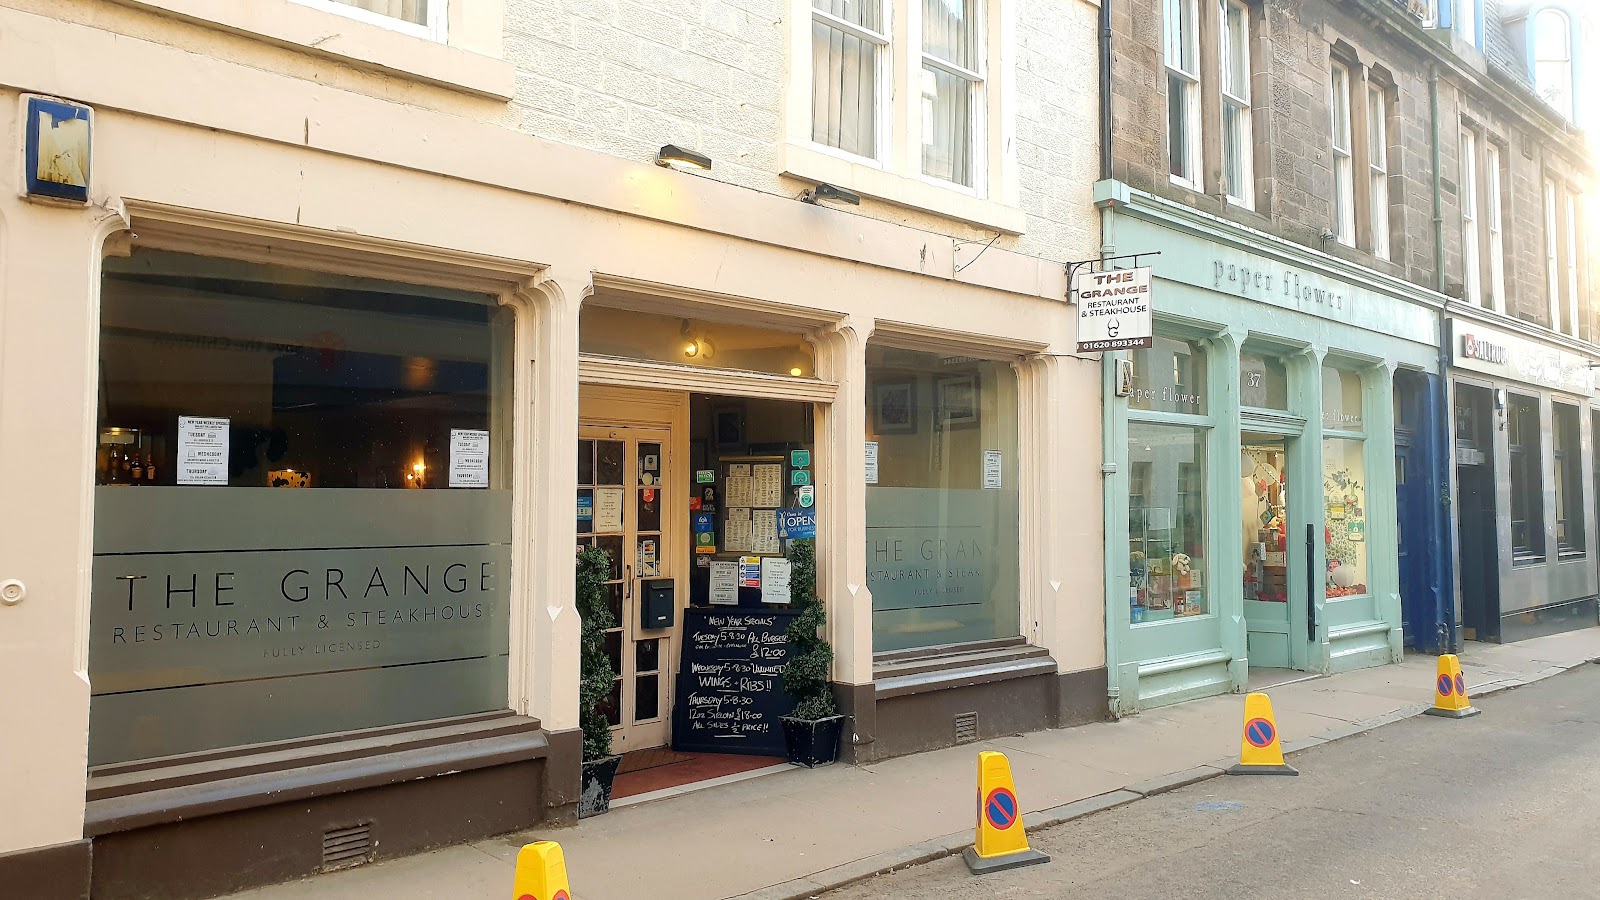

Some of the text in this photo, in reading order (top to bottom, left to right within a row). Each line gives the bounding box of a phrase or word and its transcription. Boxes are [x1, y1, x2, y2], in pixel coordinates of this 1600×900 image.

[1094, 272, 1133, 286] THE
[1213, 259, 1273, 295] paper
[1080, 285, 1148, 299] GRANGE
[1087, 297, 1140, 309] RESTAURANT
[1089, 304, 1147, 317] STEAKHOUSE
[1083, 339, 1145, 350] 01620 893344
[1247, 371, 1262, 388] 37
[1129, 386, 1200, 405] aper flower
[787, 516, 816, 527] OPEN
[866, 539, 982, 562] HE GRAN
[870, 568, 930, 582] STAURANT
[115, 562, 495, 611] THE GRANGE
[113, 615, 300, 644] RESTAURANT
[317, 613, 330, 630] &
[726, 615, 743, 628] YEAR
[692, 631, 720, 645] TUESDAY
[263, 639, 381, 659] FULLY LICENSED
[698, 675, 732, 688] WINGS
[688, 691, 724, 712] THURSDAY
[691, 720, 705, 730] ALL
